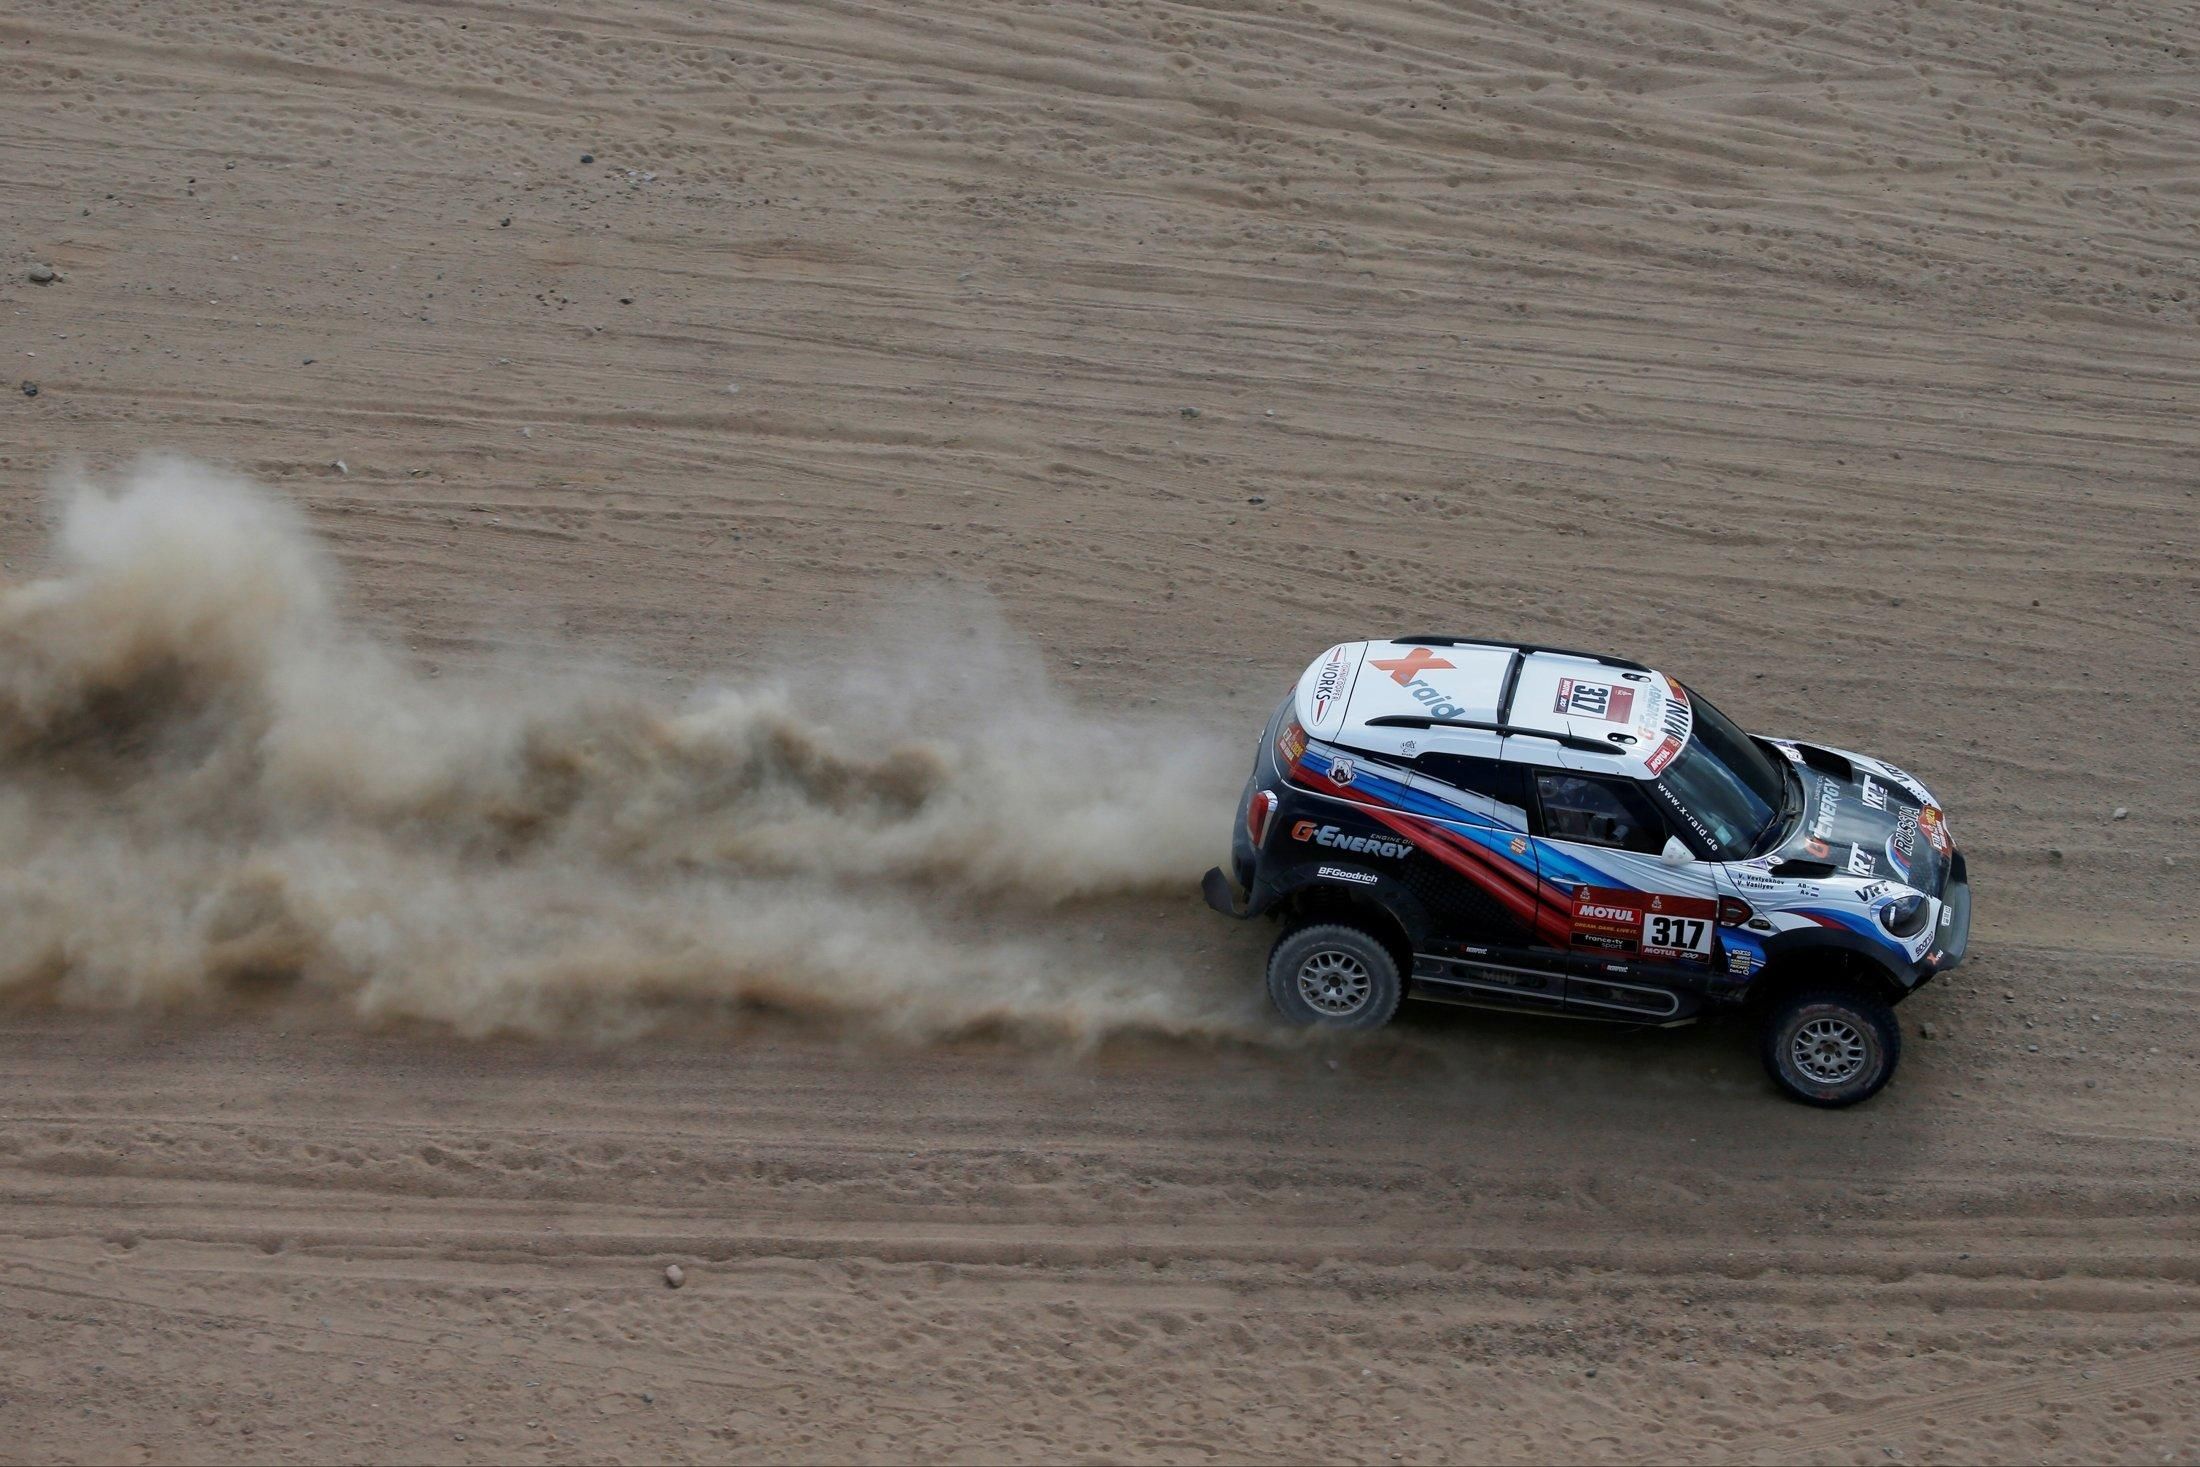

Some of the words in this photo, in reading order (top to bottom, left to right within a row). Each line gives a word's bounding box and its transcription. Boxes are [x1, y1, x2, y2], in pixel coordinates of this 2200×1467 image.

[1316, 662, 1341, 700] WORKS
[1571, 685, 1609, 714] 317
[1660, 698, 1689, 742] MINI
[1650, 747, 1671, 771] MOTUL
[1862, 774, 1885, 811] VRT
[1657, 782, 1718, 851] www.x-raid.de
[1371, 833, 1400, 843] ENGINE
[1401, 838, 1416, 846] OIL
[1893, 806, 1920, 856] RUSSIA
[1318, 866, 1379, 884] BFGoodrich
[1746, 881, 1774, 890] Vasilyev
[1855, 880, 1889, 902] VRT
[1579, 905, 1634, 922] MOTUL
[1651, 917, 1705, 950] 317
[1601, 942, 1623, 950] sport
[1644, 947, 1677, 957] MOTUL
